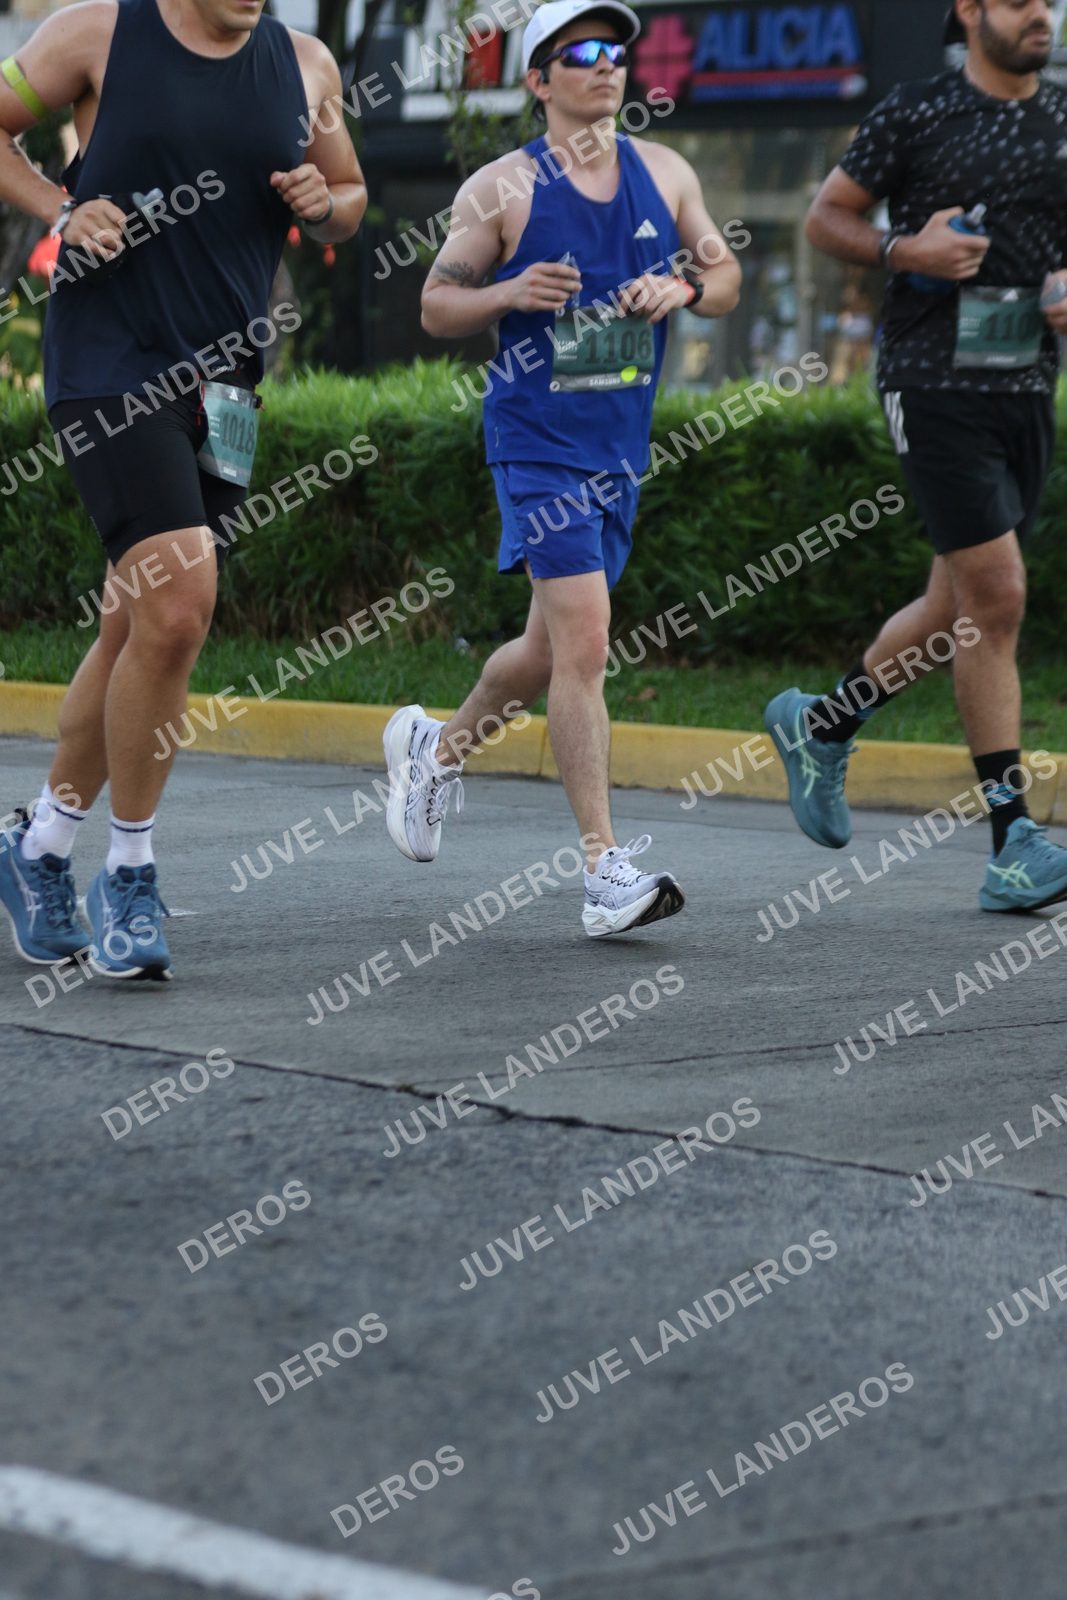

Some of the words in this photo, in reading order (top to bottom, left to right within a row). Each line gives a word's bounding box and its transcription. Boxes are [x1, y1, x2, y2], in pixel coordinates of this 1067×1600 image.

[693, 5, 862, 70] ALICIA
[585, 329, 651, 364] 1106
[222, 411, 255, 455] 1018
